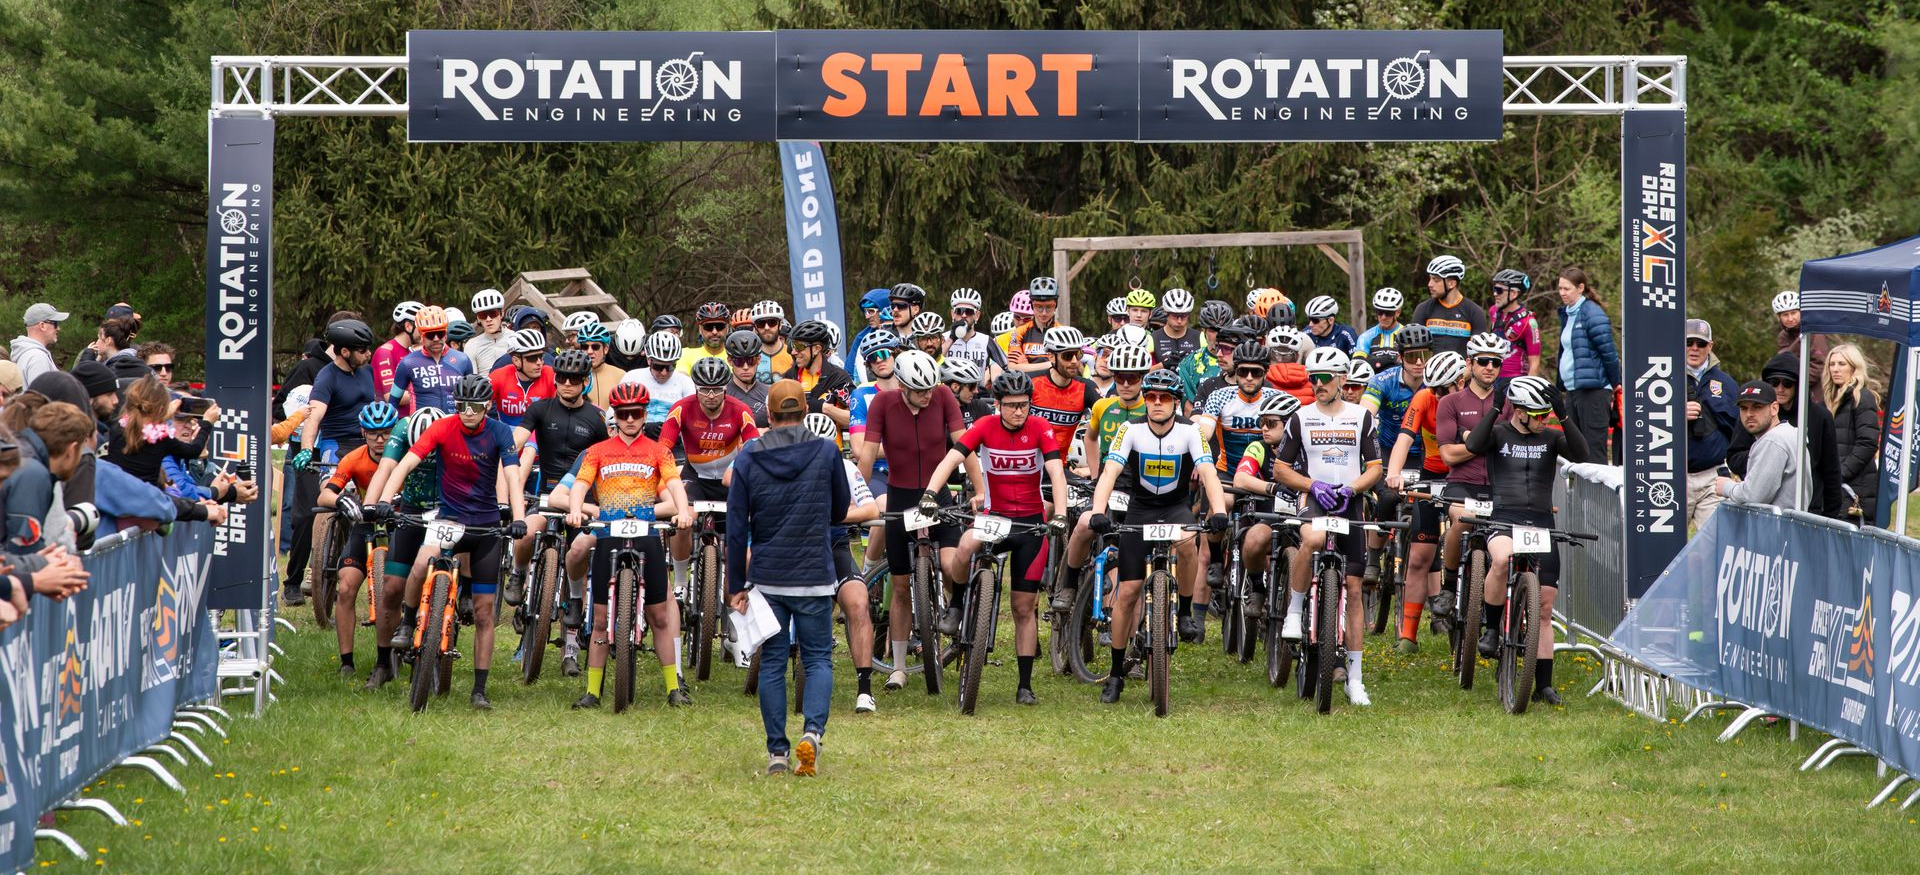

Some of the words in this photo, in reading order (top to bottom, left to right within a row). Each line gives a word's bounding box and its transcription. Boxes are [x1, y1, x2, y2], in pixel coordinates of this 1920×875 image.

[442, 54, 741, 119] ROTATION
[822, 52, 1092, 117] START
[1171, 53, 1466, 120] ROTATION
[502, 108, 741, 121] ENGINEERING
[1230, 107, 1466, 121] ENGINEERING
[1642, 174, 1658, 220] DAY
[1659, 162, 1676, 222] RACE
[248, 183, 261, 326] ENGINEERING
[1632, 218, 1640, 282] CHAMPIONSHIP
[1642, 220, 1676, 287] XC
[218, 183, 257, 360] ROTATION
[413, 364, 444, 379] FAST
[1029, 408, 1050, 420] 545
[1052, 412, 1078, 423] VELO
[701, 431, 724, 441] ZERO
[1636, 356, 1678, 533] ROTATION
[249, 435, 258, 486] MPIONSHIP
[701, 449, 725, 457] ZERO
[990, 455, 1036, 469] WPI
[1636, 391, 1645, 533] ENGINEERING
[621, 520, 638, 535] 25
[984, 520, 1001, 535] 57
[1326, 518, 1339, 528] 13
[436, 525, 454, 541] 65
[1150, 525, 1174, 539] 267
[1523, 531, 1540, 546] 64
